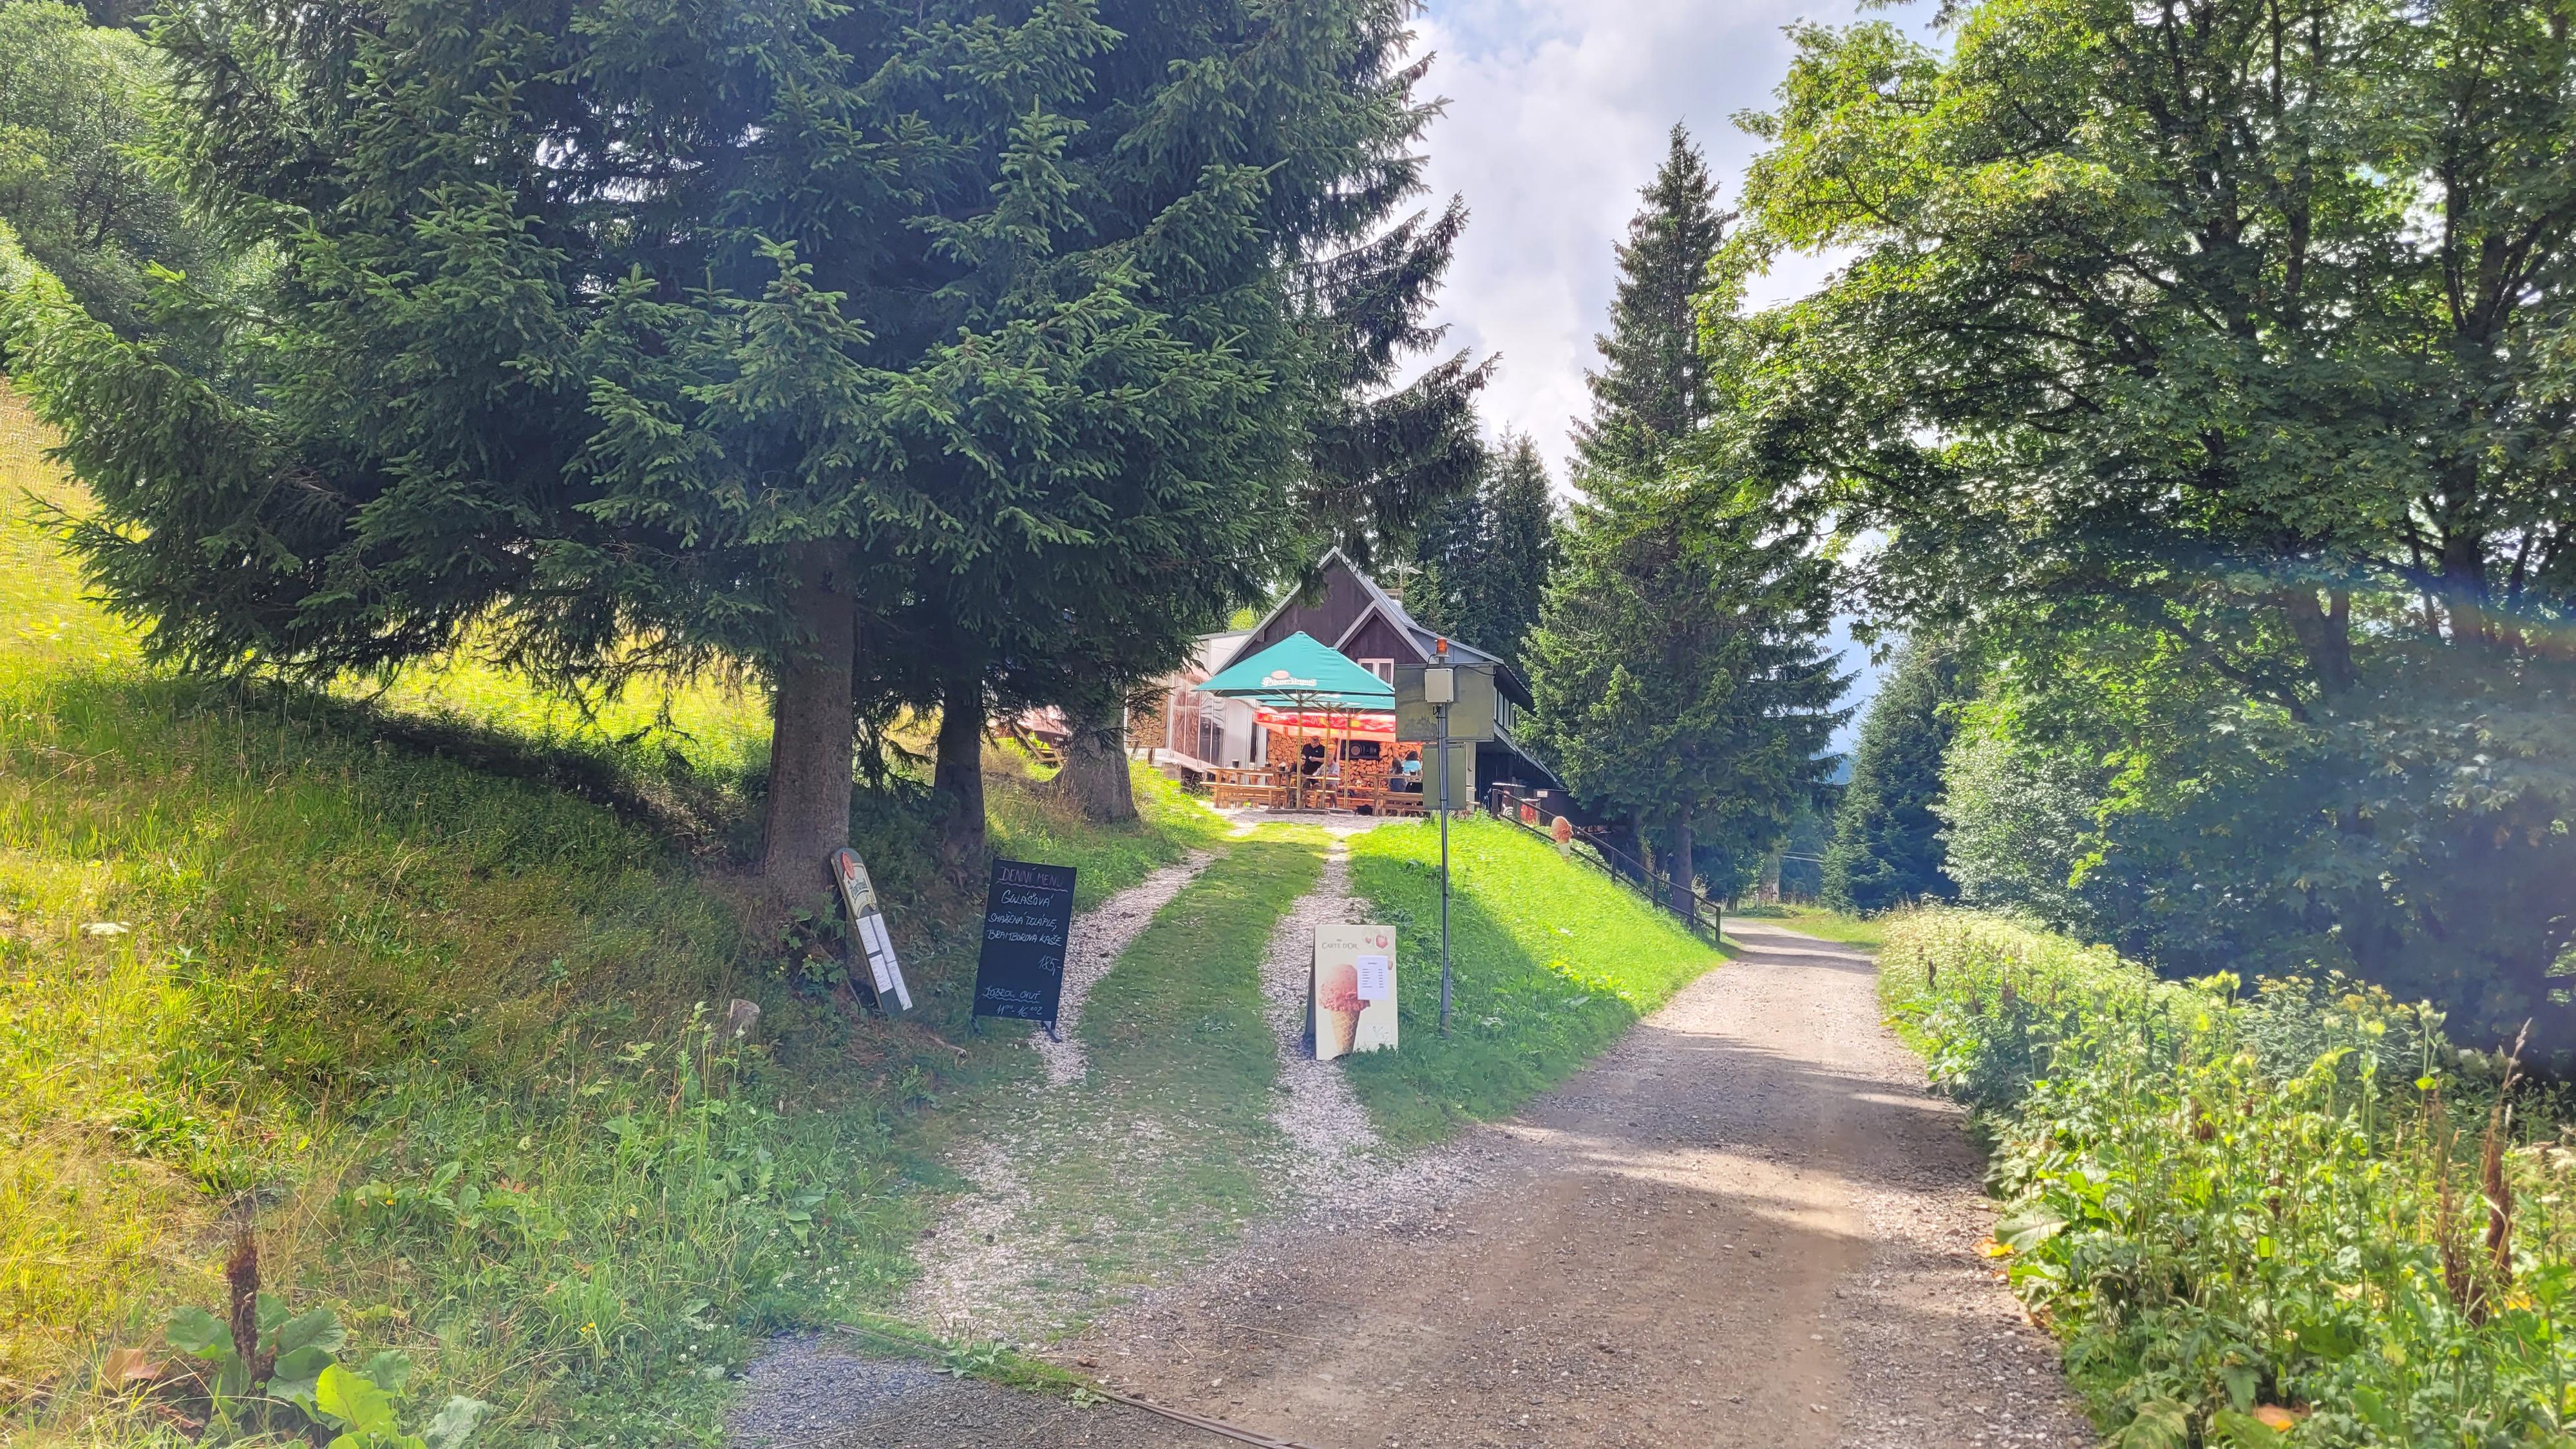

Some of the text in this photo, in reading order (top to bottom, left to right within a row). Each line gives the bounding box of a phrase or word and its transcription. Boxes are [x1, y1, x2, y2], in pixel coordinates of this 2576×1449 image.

[998, 867, 1037, 884] DENNÍ
[1001, 889, 1054, 907] GULÁŠOVÁ
[1039, 933, 1062, 947] KAŠE
